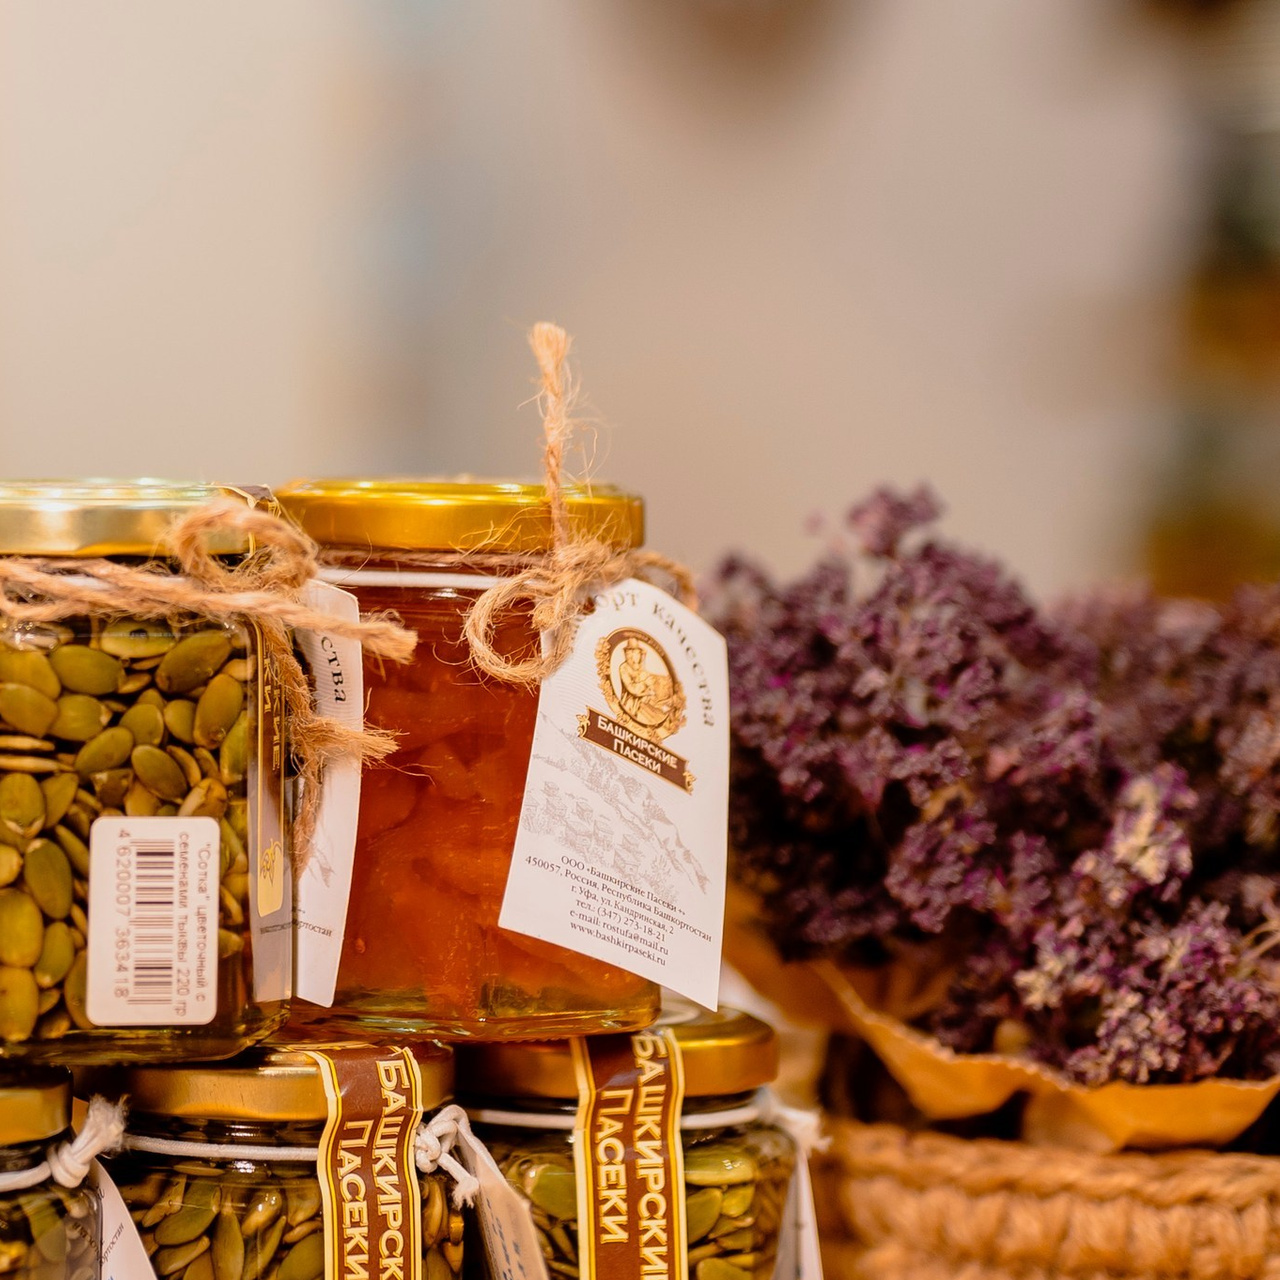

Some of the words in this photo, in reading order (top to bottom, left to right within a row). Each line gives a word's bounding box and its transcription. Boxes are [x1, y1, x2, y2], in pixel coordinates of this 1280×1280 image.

[320, 636, 347, 704] ства
[597, 715, 678, 769] БАШКИРСКИЕ
[613, 739, 662, 774] ПАСЕКИ
[116, 846, 131, 917] 620007
[178, 832, 189, 909] семенами
[525, 855, 563, 876] 450057,
[565, 868, 600, 890] Россия,
[602, 883, 652, 912] Республика
[654, 906, 712, 942] Башкортостан
[561, 855, 585, 871] ООО
[647, 891, 677, 913] Пасеки
[579, 886, 598, 902] Уфа,
[601, 896, 613, 908] ул.
[177, 915, 188, 963] тыквы
[196, 907, 211, 989] цветочный
[569, 909, 601, 926] e-mail:
[602, 921, 669, 956] rostufa@mail.ru
[570, 922, 666, 966] www.bashkirpaseki.ru
[597, 906, 622, 924] (347)
[623, 916, 666, 942] 273-18-21
[114, 928, 130, 999] 363418
[176, 968, 190, 996] 220
[595, 1089, 634, 1244] ПАСЕКИ
[631, 1034, 669, 1280] БАШКИРСКИ
[337, 1119, 374, 1280] ПАСЕКИ
